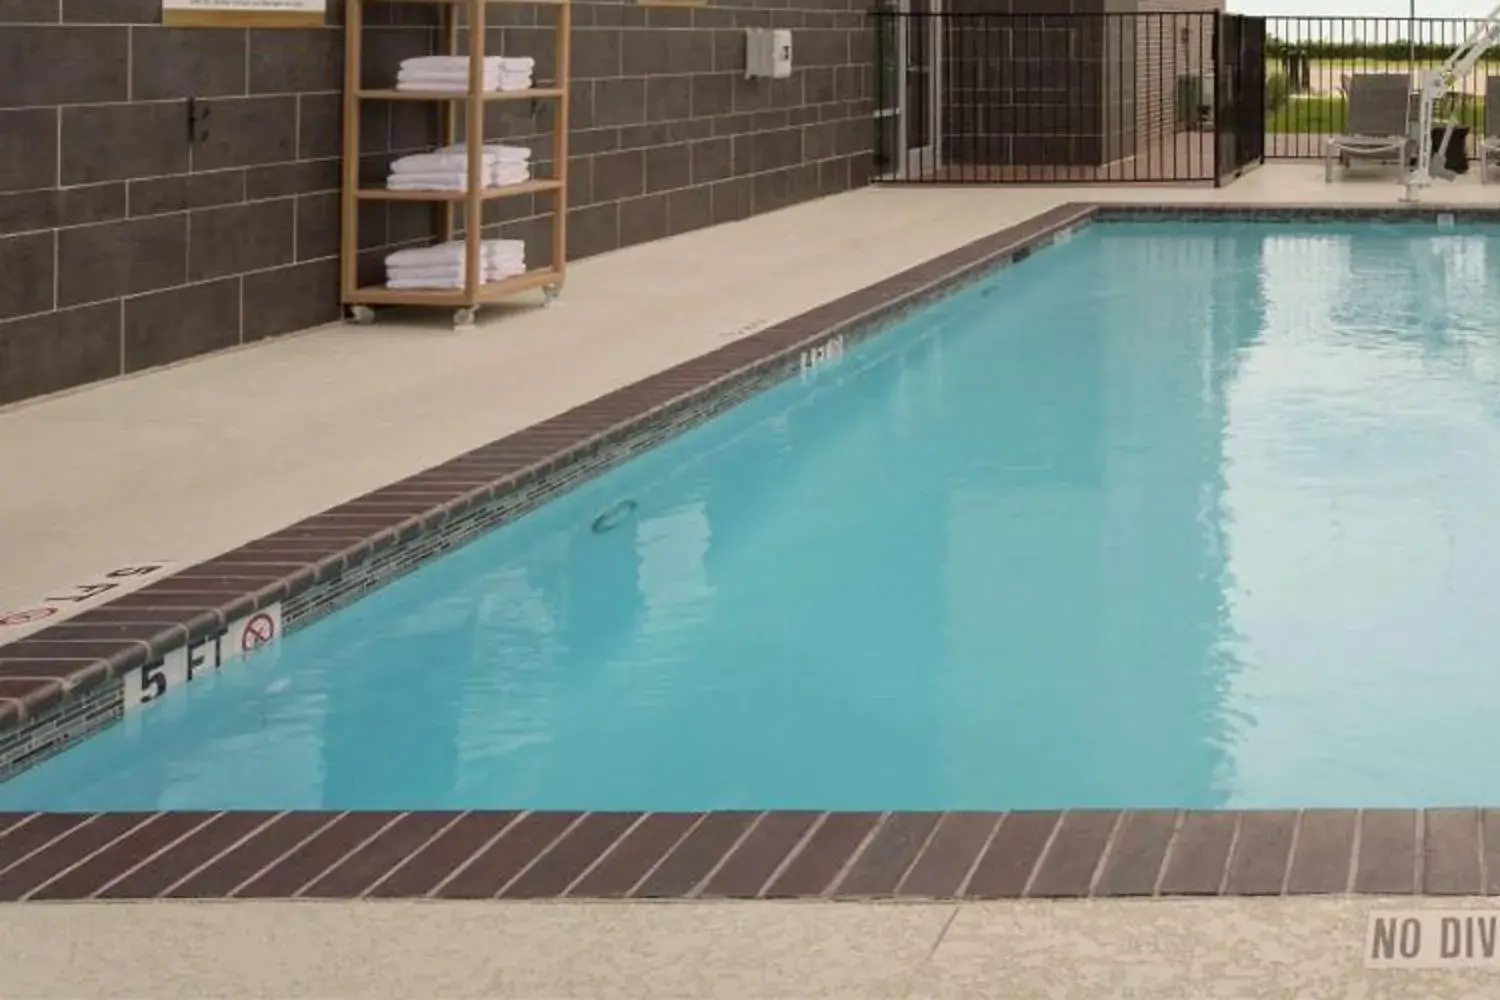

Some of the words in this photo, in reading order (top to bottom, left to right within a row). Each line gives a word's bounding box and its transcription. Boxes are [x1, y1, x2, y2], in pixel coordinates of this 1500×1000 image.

[141, 655, 167, 703] 5
[186, 624, 229, 682] FT
[1371, 917, 1422, 960] NO
